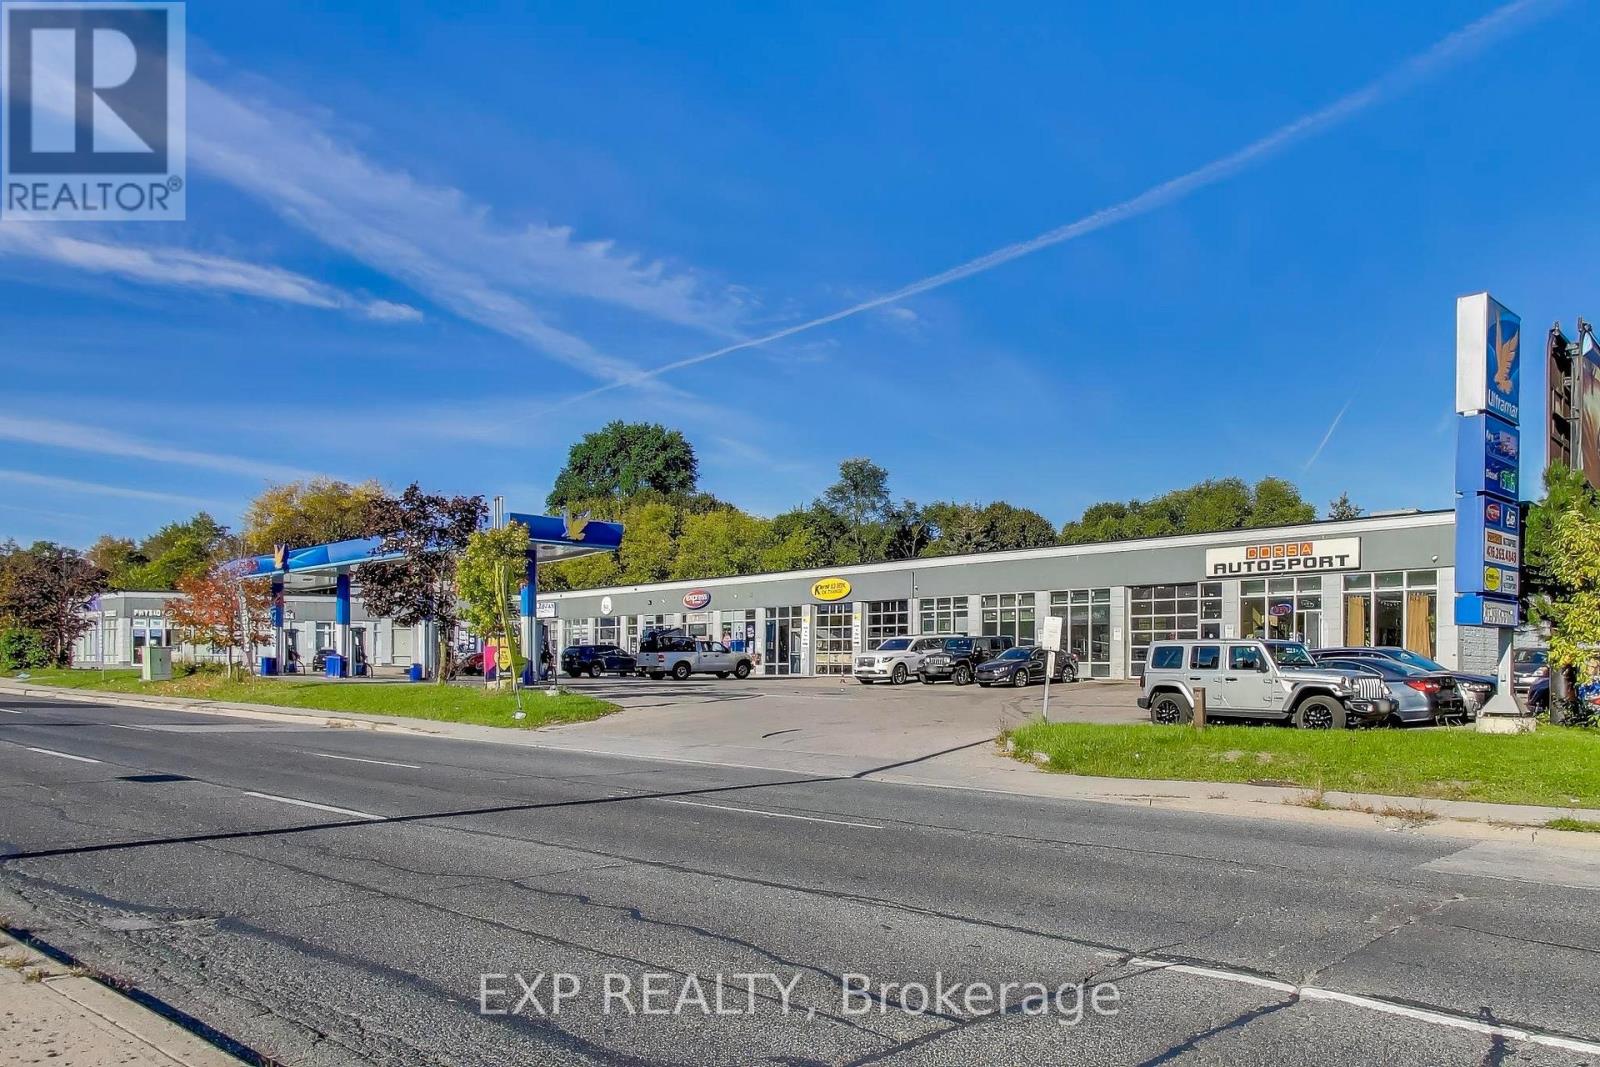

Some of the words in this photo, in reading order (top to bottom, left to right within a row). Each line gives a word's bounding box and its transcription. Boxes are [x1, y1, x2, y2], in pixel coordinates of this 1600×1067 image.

[1488, 389, 1518, 418] Ultramar
[1246, 542, 1313, 559] CORSA
[1213, 554, 1349, 574] AUTOSPORT
